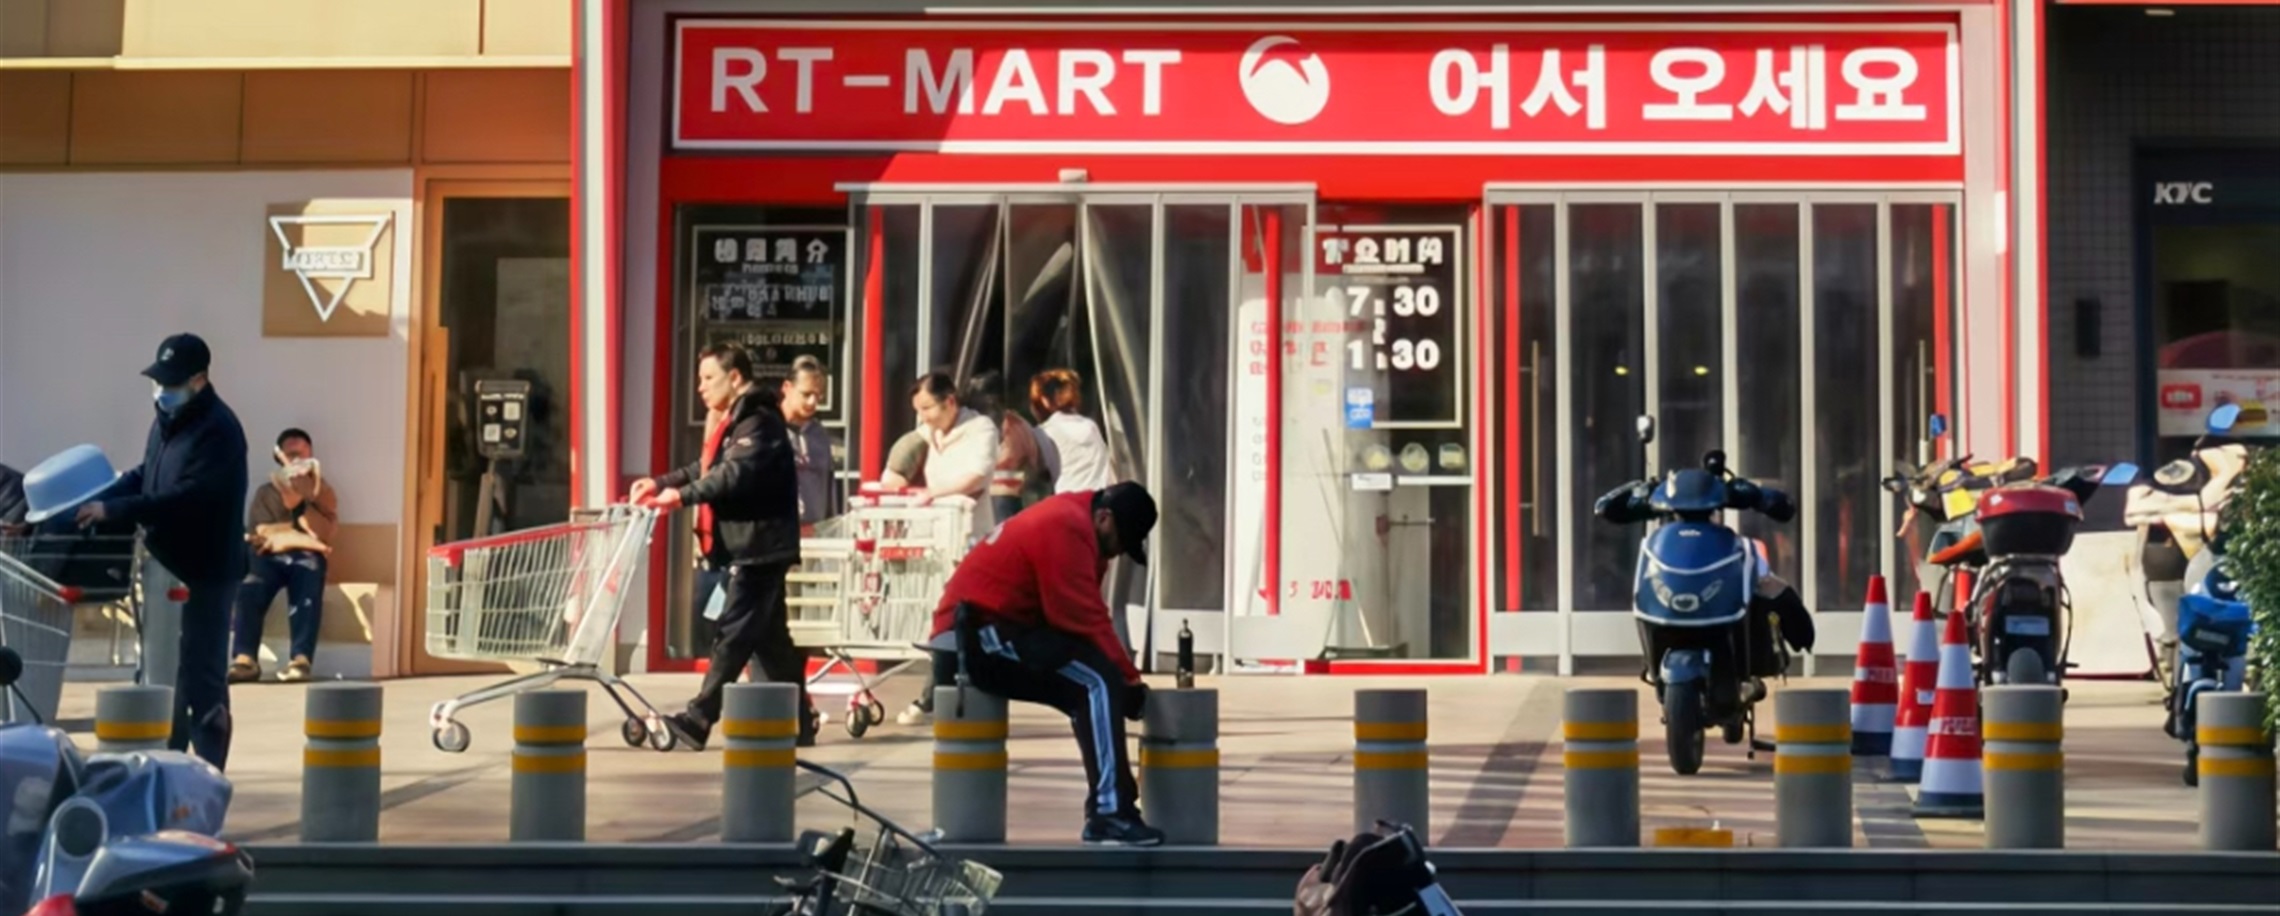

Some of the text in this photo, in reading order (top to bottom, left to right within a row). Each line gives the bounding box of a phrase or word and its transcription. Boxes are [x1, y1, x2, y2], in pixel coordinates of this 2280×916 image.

[710, 47, 1183, 117] RT-MART
[1427, 43, 1928, 131] 어서 오세요
